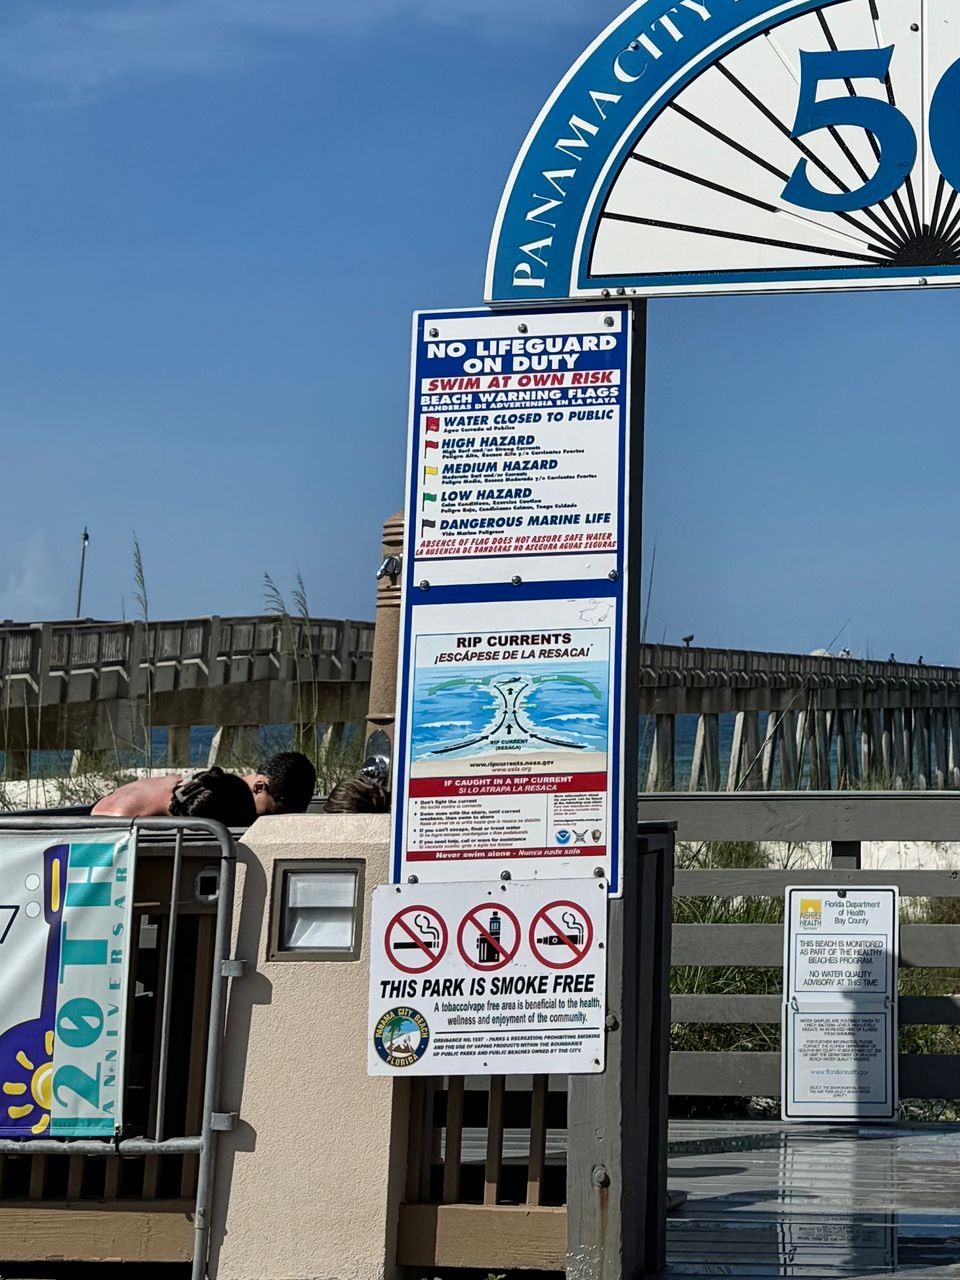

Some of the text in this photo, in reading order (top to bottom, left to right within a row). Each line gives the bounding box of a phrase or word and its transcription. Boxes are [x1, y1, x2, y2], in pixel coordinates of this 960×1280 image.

[512, 90, 622, 288] PANAMA
[427, 335, 617, 358] NO LIFEGUARD
[463, 353, 580, 374] ON DUTY
[428, 371, 614, 391] SWIM AT OWN RISK
[421, 387, 619, 405] BEACH WARNING FLAGS
[444, 409, 614, 427] WATER CLOSED TO PUBLIC
[442, 435, 535, 449] HIGH HAZARD
[442, 459, 558, 475] MEDIUM HAZARD
[441, 488, 532, 502] LOW HAZARD
[440, 512, 611, 530] DANGEROUS MARINE LIFE
[420, 532, 612, 547] ABSENCE OF FLAG DOES NOT ASSURE SAFE WATER
[456, 633, 572, 648] RIP CURRENTS
[434, 647, 590, 665] ¡ESCÁPESE DE LA RESACA!
[455, 778, 492, 786] CAUGHT
[834, 917, 869, 926] Bay County
[53, 843, 117, 1110] 20TH
[380, 974, 595, 998] THIS PARK IS SMOKE FREE
[434, 1002, 440, 1012] A
[487, 1000, 500, 1011] free
[517, 999, 523, 1010] is
[525, 998, 556, 1009] beneficial
[558, 999, 566, 1008] to
[567, 998, 578, 1008] the
[579, 997, 601, 1010] health,
[375, 1008, 429, 1038] PANAMA CITY BEACH
[448, 1011, 587, 1026] wellness and enjoyment of the community.
[386, 1053, 419, 1066] FLORIDA
